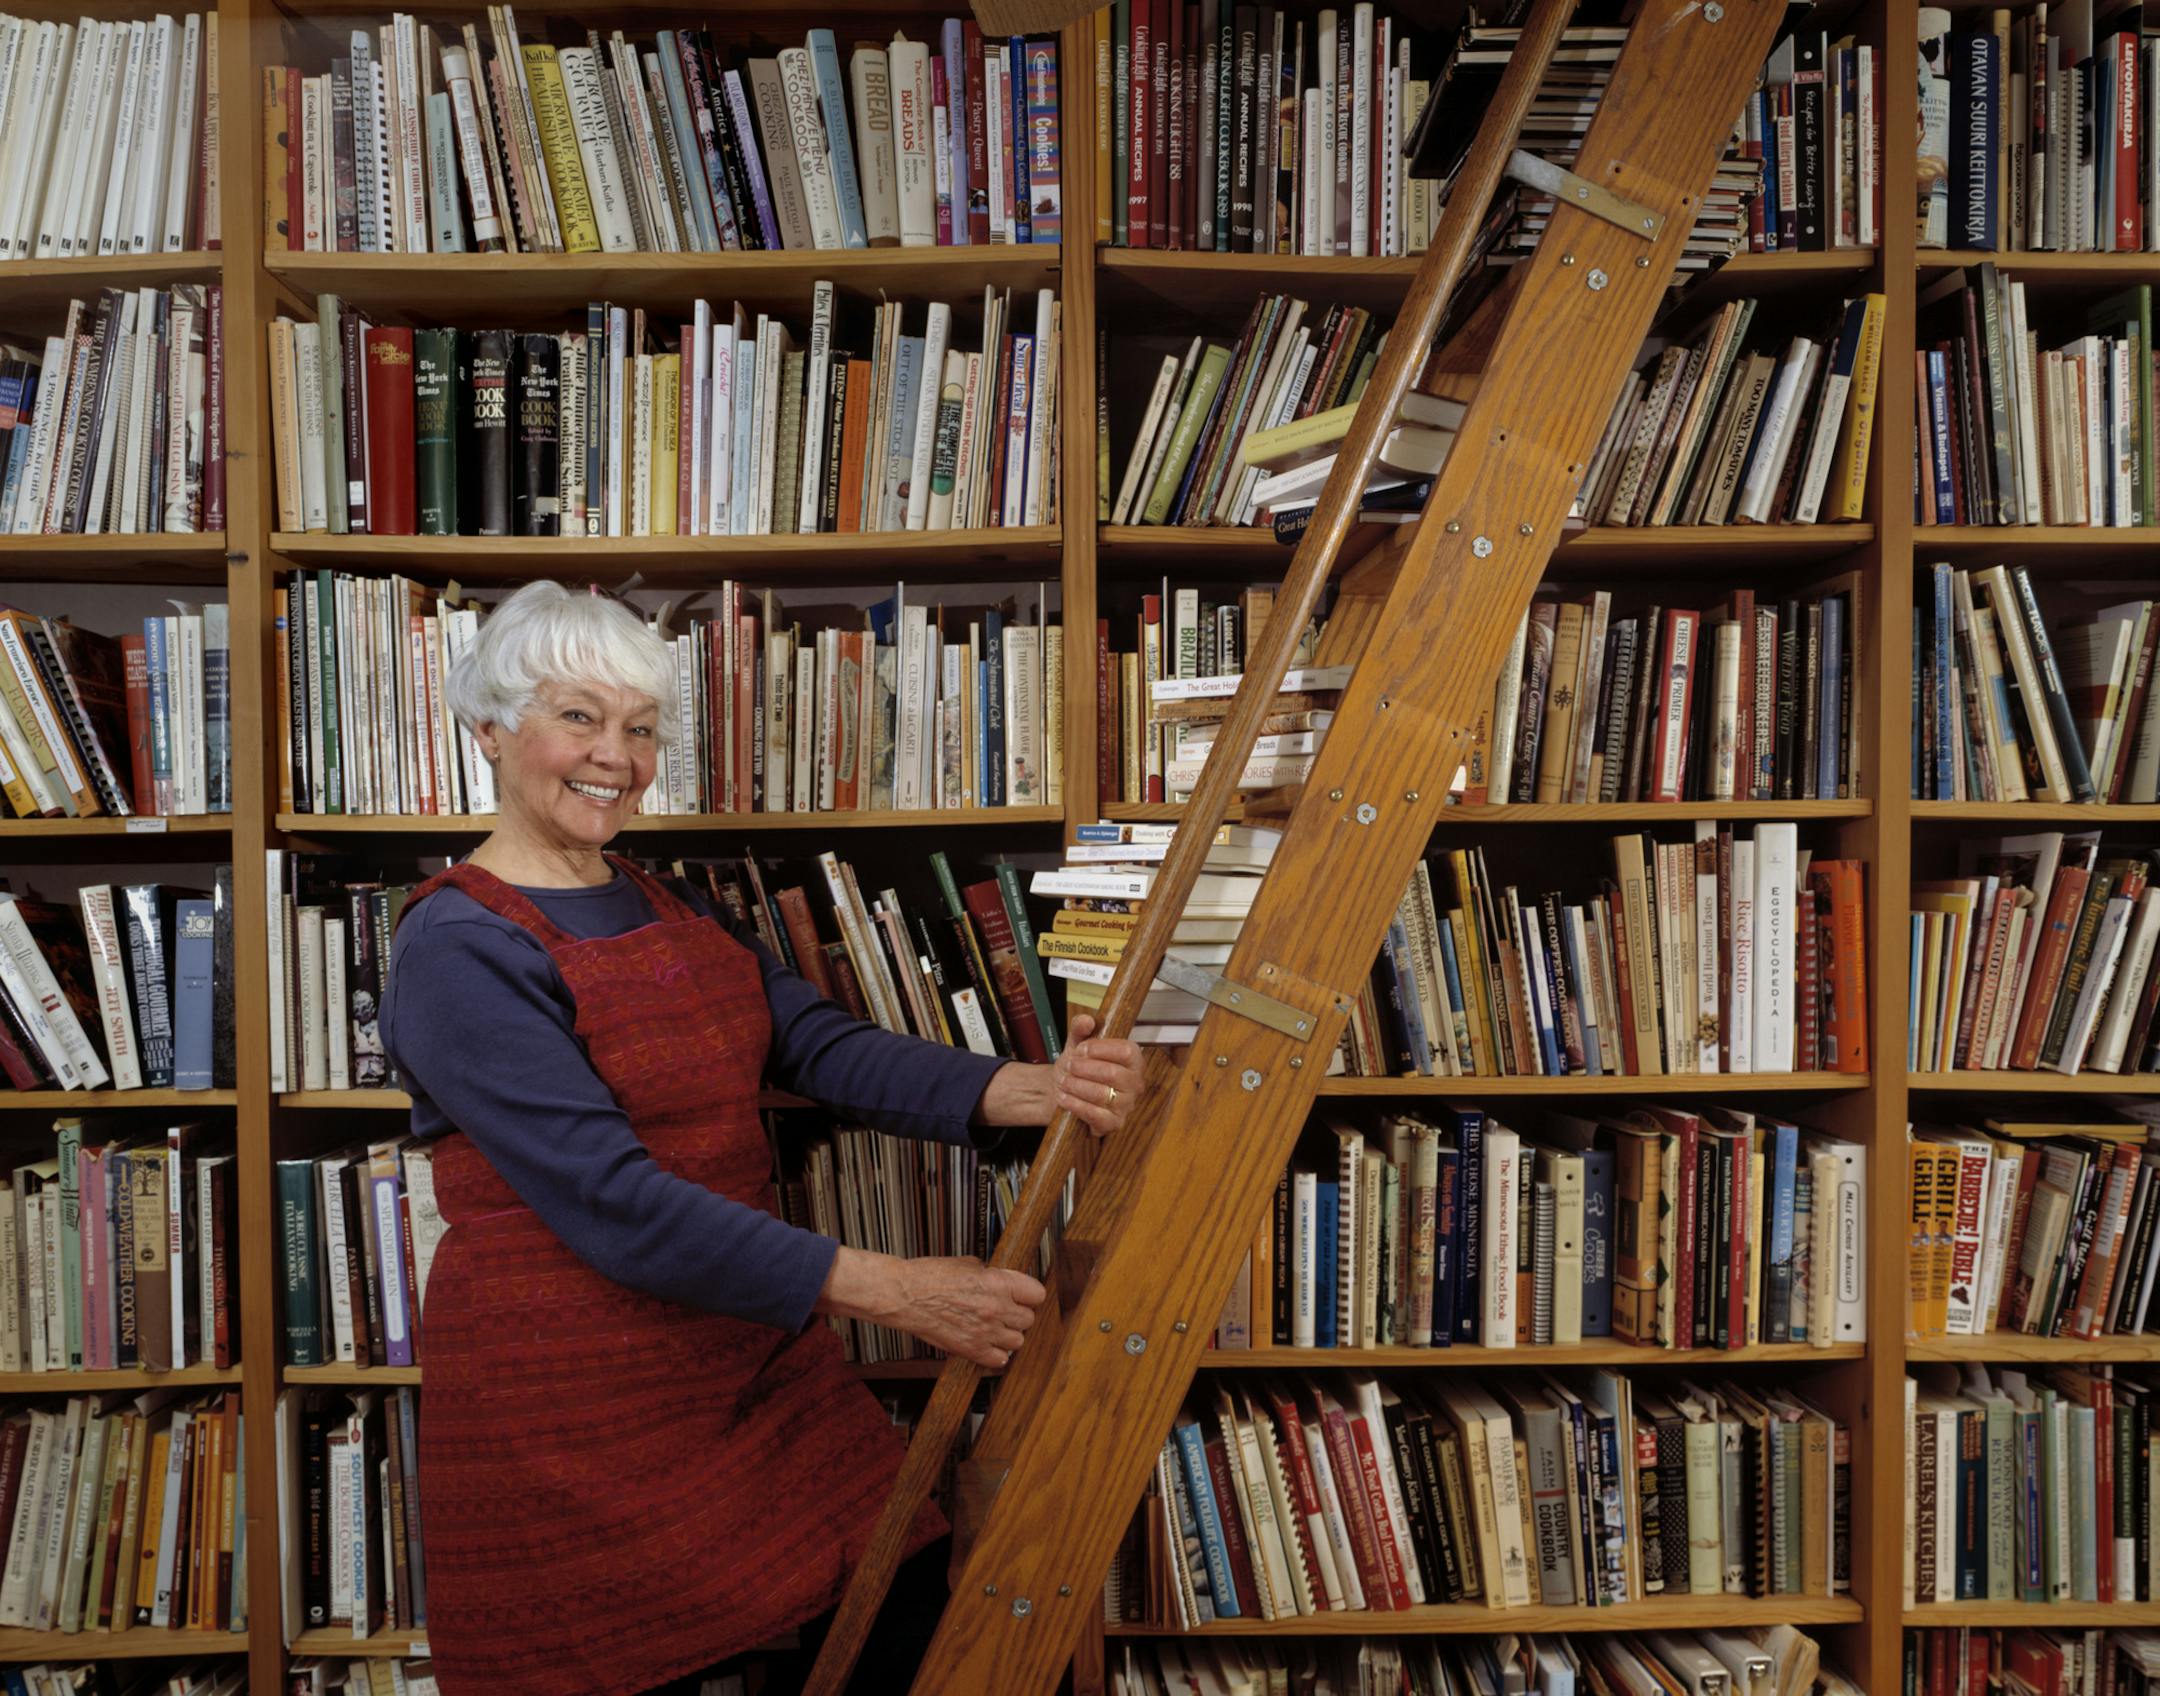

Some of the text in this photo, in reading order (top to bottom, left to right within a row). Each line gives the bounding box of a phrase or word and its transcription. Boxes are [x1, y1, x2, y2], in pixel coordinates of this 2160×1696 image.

[564, 55, 596, 145] GOURMET
[581, 55, 611, 145] MICROWAVE
[711, 88, 729, 134] America
[758, 82, 778, 150] COOKING
[789, 74, 809, 157] COOKBOOK
[865, 72, 889, 131] BREAD
[902, 89, 914, 151] BREADS
[972, 102, 983, 135] Pastry
[1325, 82, 1334, 150] SPA FOOD
[2123, 43, 2134, 148] LEIVONTAKIRJA
[530, 68, 579, 234] HEALTHSTYLE COOKBOOK
[549, 81, 591, 224] MICROWAVE GOURMET
[973, 138, 984, 170] Queen
[1035, 117, 1055, 172] Cookies!
[1778, 121, 1794, 206] Food Allergy Cookbook
[1966, 39, 1988, 242] OTAVAN SUURI KEITTOKIRJA
[595, 150, 614, 212] Barbara Kafka
[1233, 203, 1251, 211] 1998
[212, 293, 220, 307] The
[211, 338, 220, 359] Chefs
[211, 361, 220, 372] of
[521, 377, 558, 387] New York
[531, 364, 547, 374] The
[171, 316, 186, 496] Masterpieces of FRENCH CUISINE
[211, 375, 219, 405] France
[520, 401, 557, 413] COOK
[521, 414, 557, 426] BOOK
[526, 388, 551, 398] Times
[574, 347, 586, 486] Julie Dannenbaum's
[2120, 349, 2129, 422] Dutch Cooking
[211, 407, 219, 437] Recipe
[211, 439, 219, 462] Book
[560, 346, 574, 513] Creative Cooking School
[934, 405, 950, 473] BOOK OF MEAT
[944, 406, 960, 475] THE COMPLETE
[1722, 377, 1766, 491] TOO MANY TOMATOES
[1852, 420, 1869, 487] organic
[1936, 387, 1949, 482] Vienna & Budapest
[149, 623, 161, 692] IN GOOD TASTE
[290, 582, 303, 767] INTERNATIONAL GREAT MEALS IN MINUTES
[1670, 621, 1689, 721] CHEESE PRIMER
[1756, 626, 1772, 744] ISRAELI COOKERY
[8, 688, 45, 749] FLAVORS
[96, 891, 120, 969] THE FRUGAL
[186, 916, 213, 932] JOY
[1042, 940, 1109, 956] The Finnish Cookbook
[1703, 897, 1715, 1003] World Hazelnut Tastes
[1736, 901, 1752, 994] Rice Risotto
[1770, 887, 1780, 1016] EGGCYCLOPEDIA
[301, 944, 312, 1035] ITALIAN COOKBOOK
[1544, 898, 1574, 1048] THE COFFEE COOKBOOK
[106, 986, 127, 1056] JEFF SMITH
[149, 984, 170, 1037] GOURMET
[1466, 1120, 1480, 1279] THEY CHOSE MINNESOTA
[1912, 1158, 1933, 1223] GRILL
[1935, 1158, 1957, 1222] GRILL
[1952, 1156, 1987, 1286] BARBECUE! BIBLE
[170, 1212, 180, 1254] SUMMER
[285, 1200, 297, 1292] ITALIAN COOKING
[296, 1209, 307, 1281] MORE CLASSIC
[325, 1169, 347, 1294] MARCELLA CUCINA
[1497, 1158, 1510, 1320] The Minnesota Ethnic Food Book
[2071, 1209, 2097, 1281] Grill Italian
[121, 1286, 136, 1345] COOKING
[214, 1247, 225, 1327] THANKSGIVING
[1546, 1450, 1555, 1489] FARM
[1590, 1429, 1598, 1448] THE
[1591, 1449, 1599, 1473] WILD
[16, 1425, 45, 1544] THE SILVER PALATE COOKBOOK
[1361, 1451, 1400, 1583] Mr. Food Cooks Real American
[1920, 1420, 1935, 1596] LAUREL'S KITCHEN
[351, 1453, 364, 1600] SOUTHWEST COOKING
[391, 1482, 406, 1568] The Tortilla Book
[1187, 1443, 1230, 1604] AMERICAN FOLKLIFE COOKBOOK
[1538, 1503, 1556, 1572] COOKBOOK
[1553, 1502, 1569, 1559] COUNTRY
